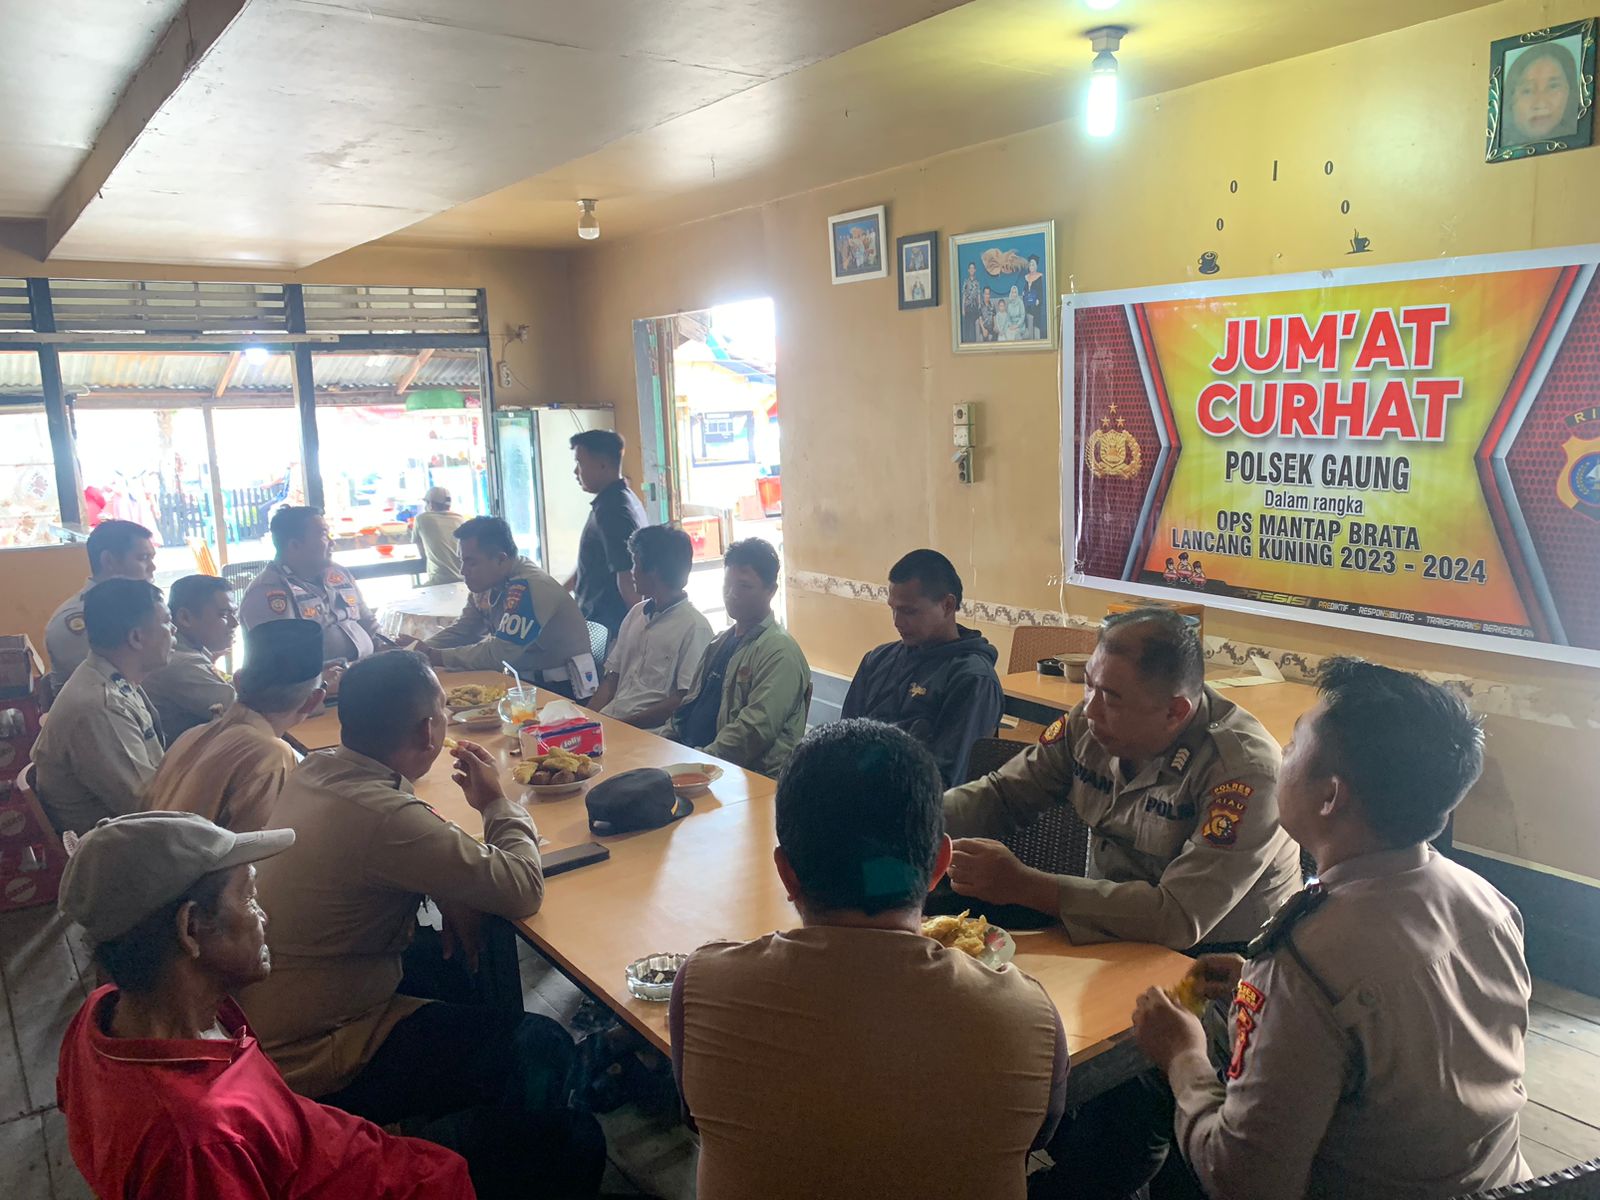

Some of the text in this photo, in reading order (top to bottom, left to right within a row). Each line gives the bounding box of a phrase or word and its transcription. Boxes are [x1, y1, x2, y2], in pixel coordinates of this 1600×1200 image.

[1210, 305, 1448, 374] JUM'AT
[1197, 379, 1461, 441] CURHAT
[1225, 450, 1410, 491] POLSEK GAUNG
[1265, 490, 1363, 517] Dalam rangka
[1217, 510, 1420, 550] OPS MANTAP BRATA
[1172, 528, 1252, 557] LANCANG
[1259, 537, 1333, 567] KUNING
[1341, 546, 1396, 573] 2023
[1423, 555, 1486, 584] 2024
[1318, 600, 1349, 612] PREDIKTIF
[1215, 798, 1244, 810] RIAU
